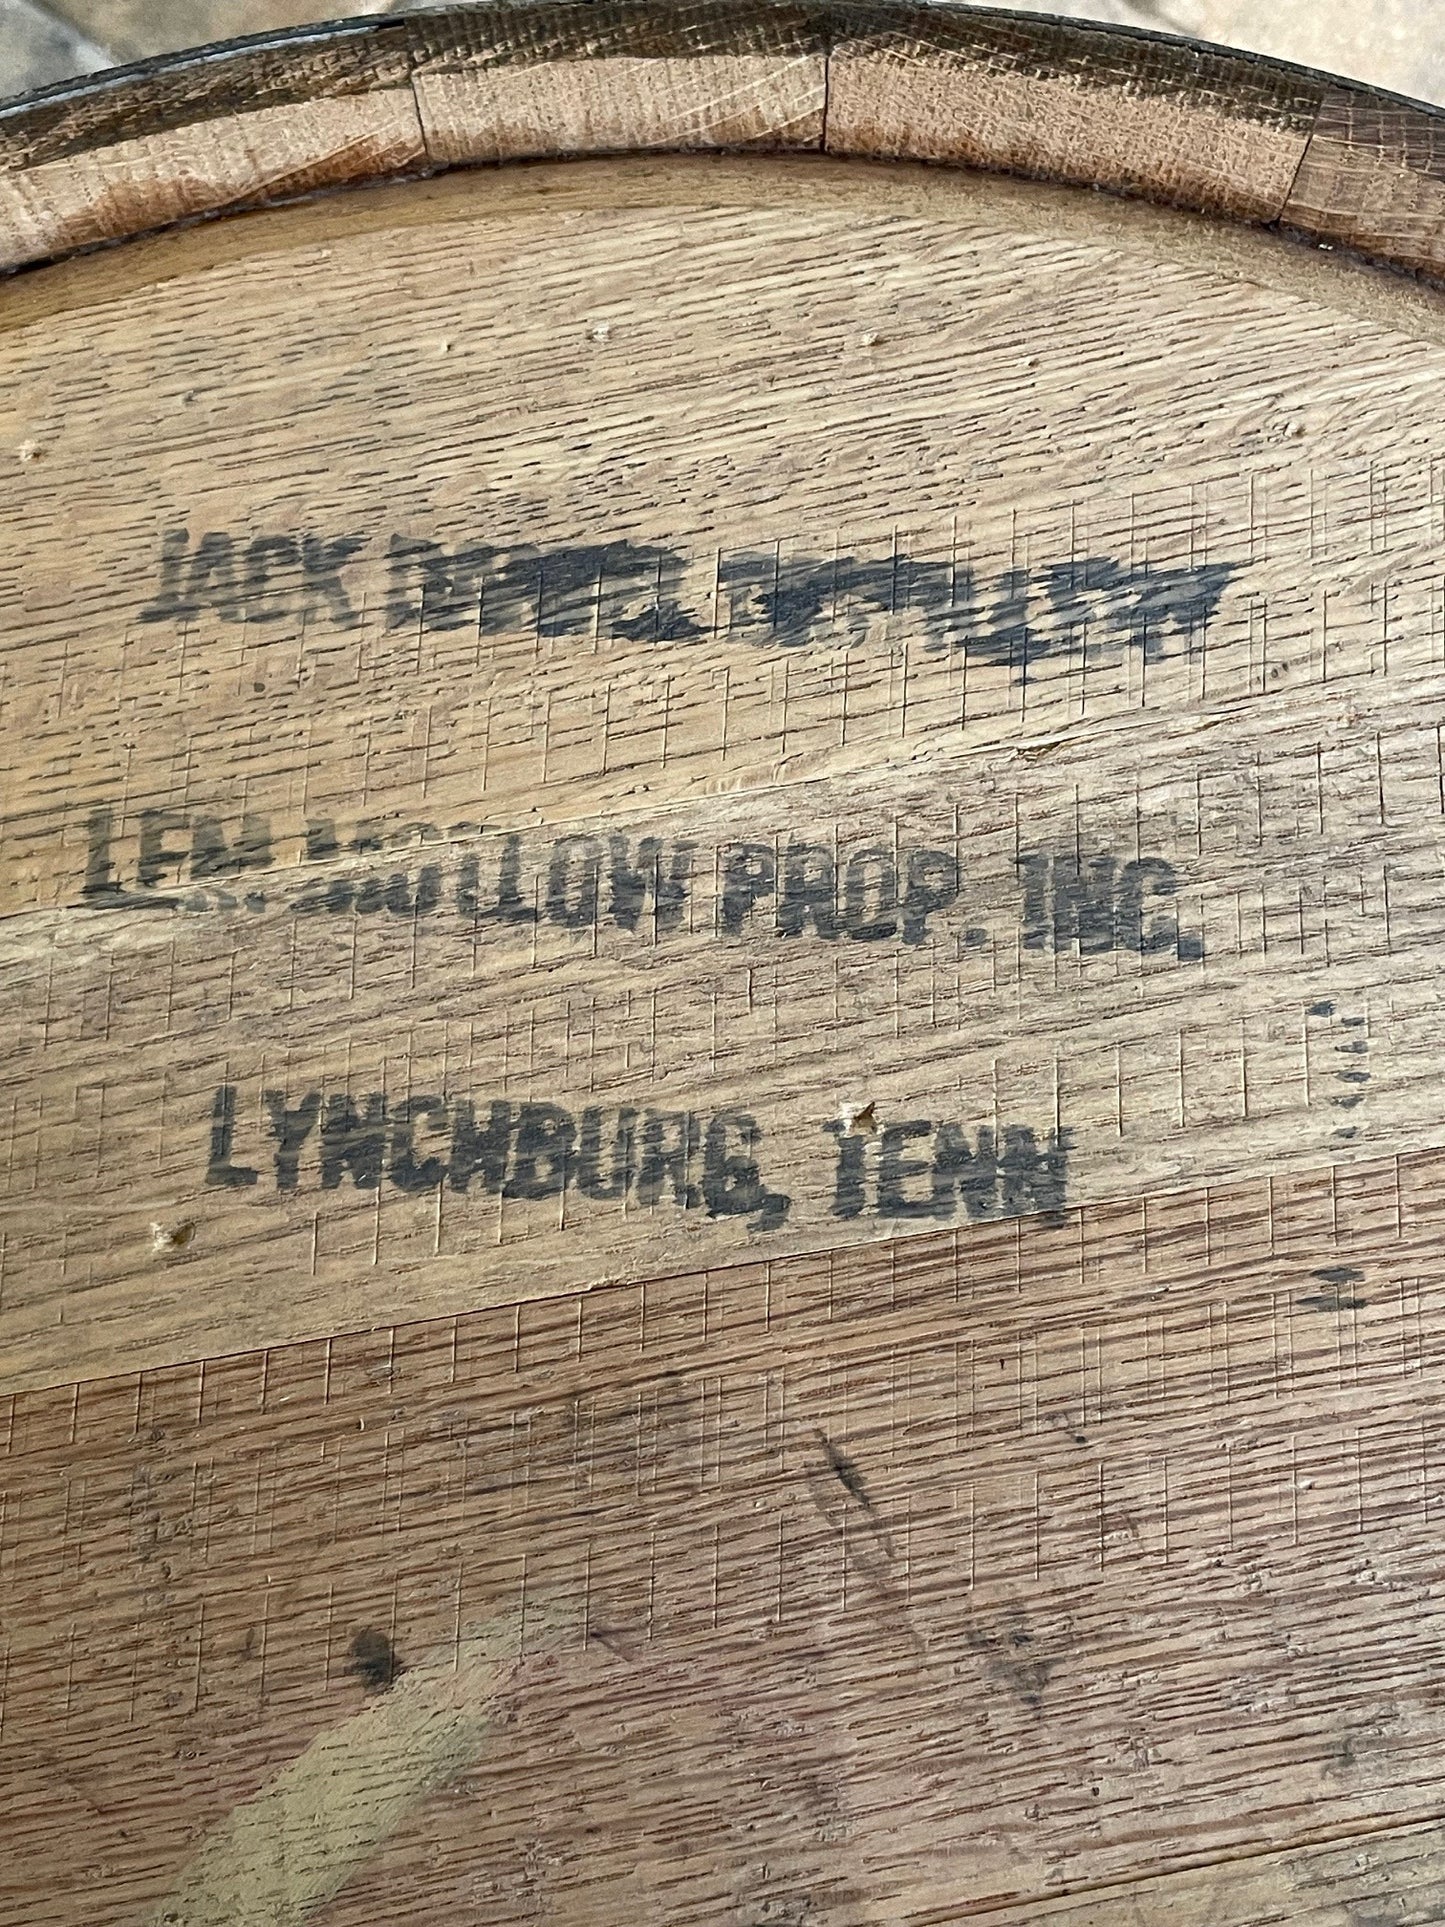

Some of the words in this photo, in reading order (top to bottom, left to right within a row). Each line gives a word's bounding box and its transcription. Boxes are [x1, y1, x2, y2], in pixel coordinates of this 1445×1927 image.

[139, 526, 366, 631] JACK
[718, 838, 988, 947] PROP.
[205, 1084, 792, 1233] LYNCHBURG,
[822, 1117, 1072, 1229] TENN
